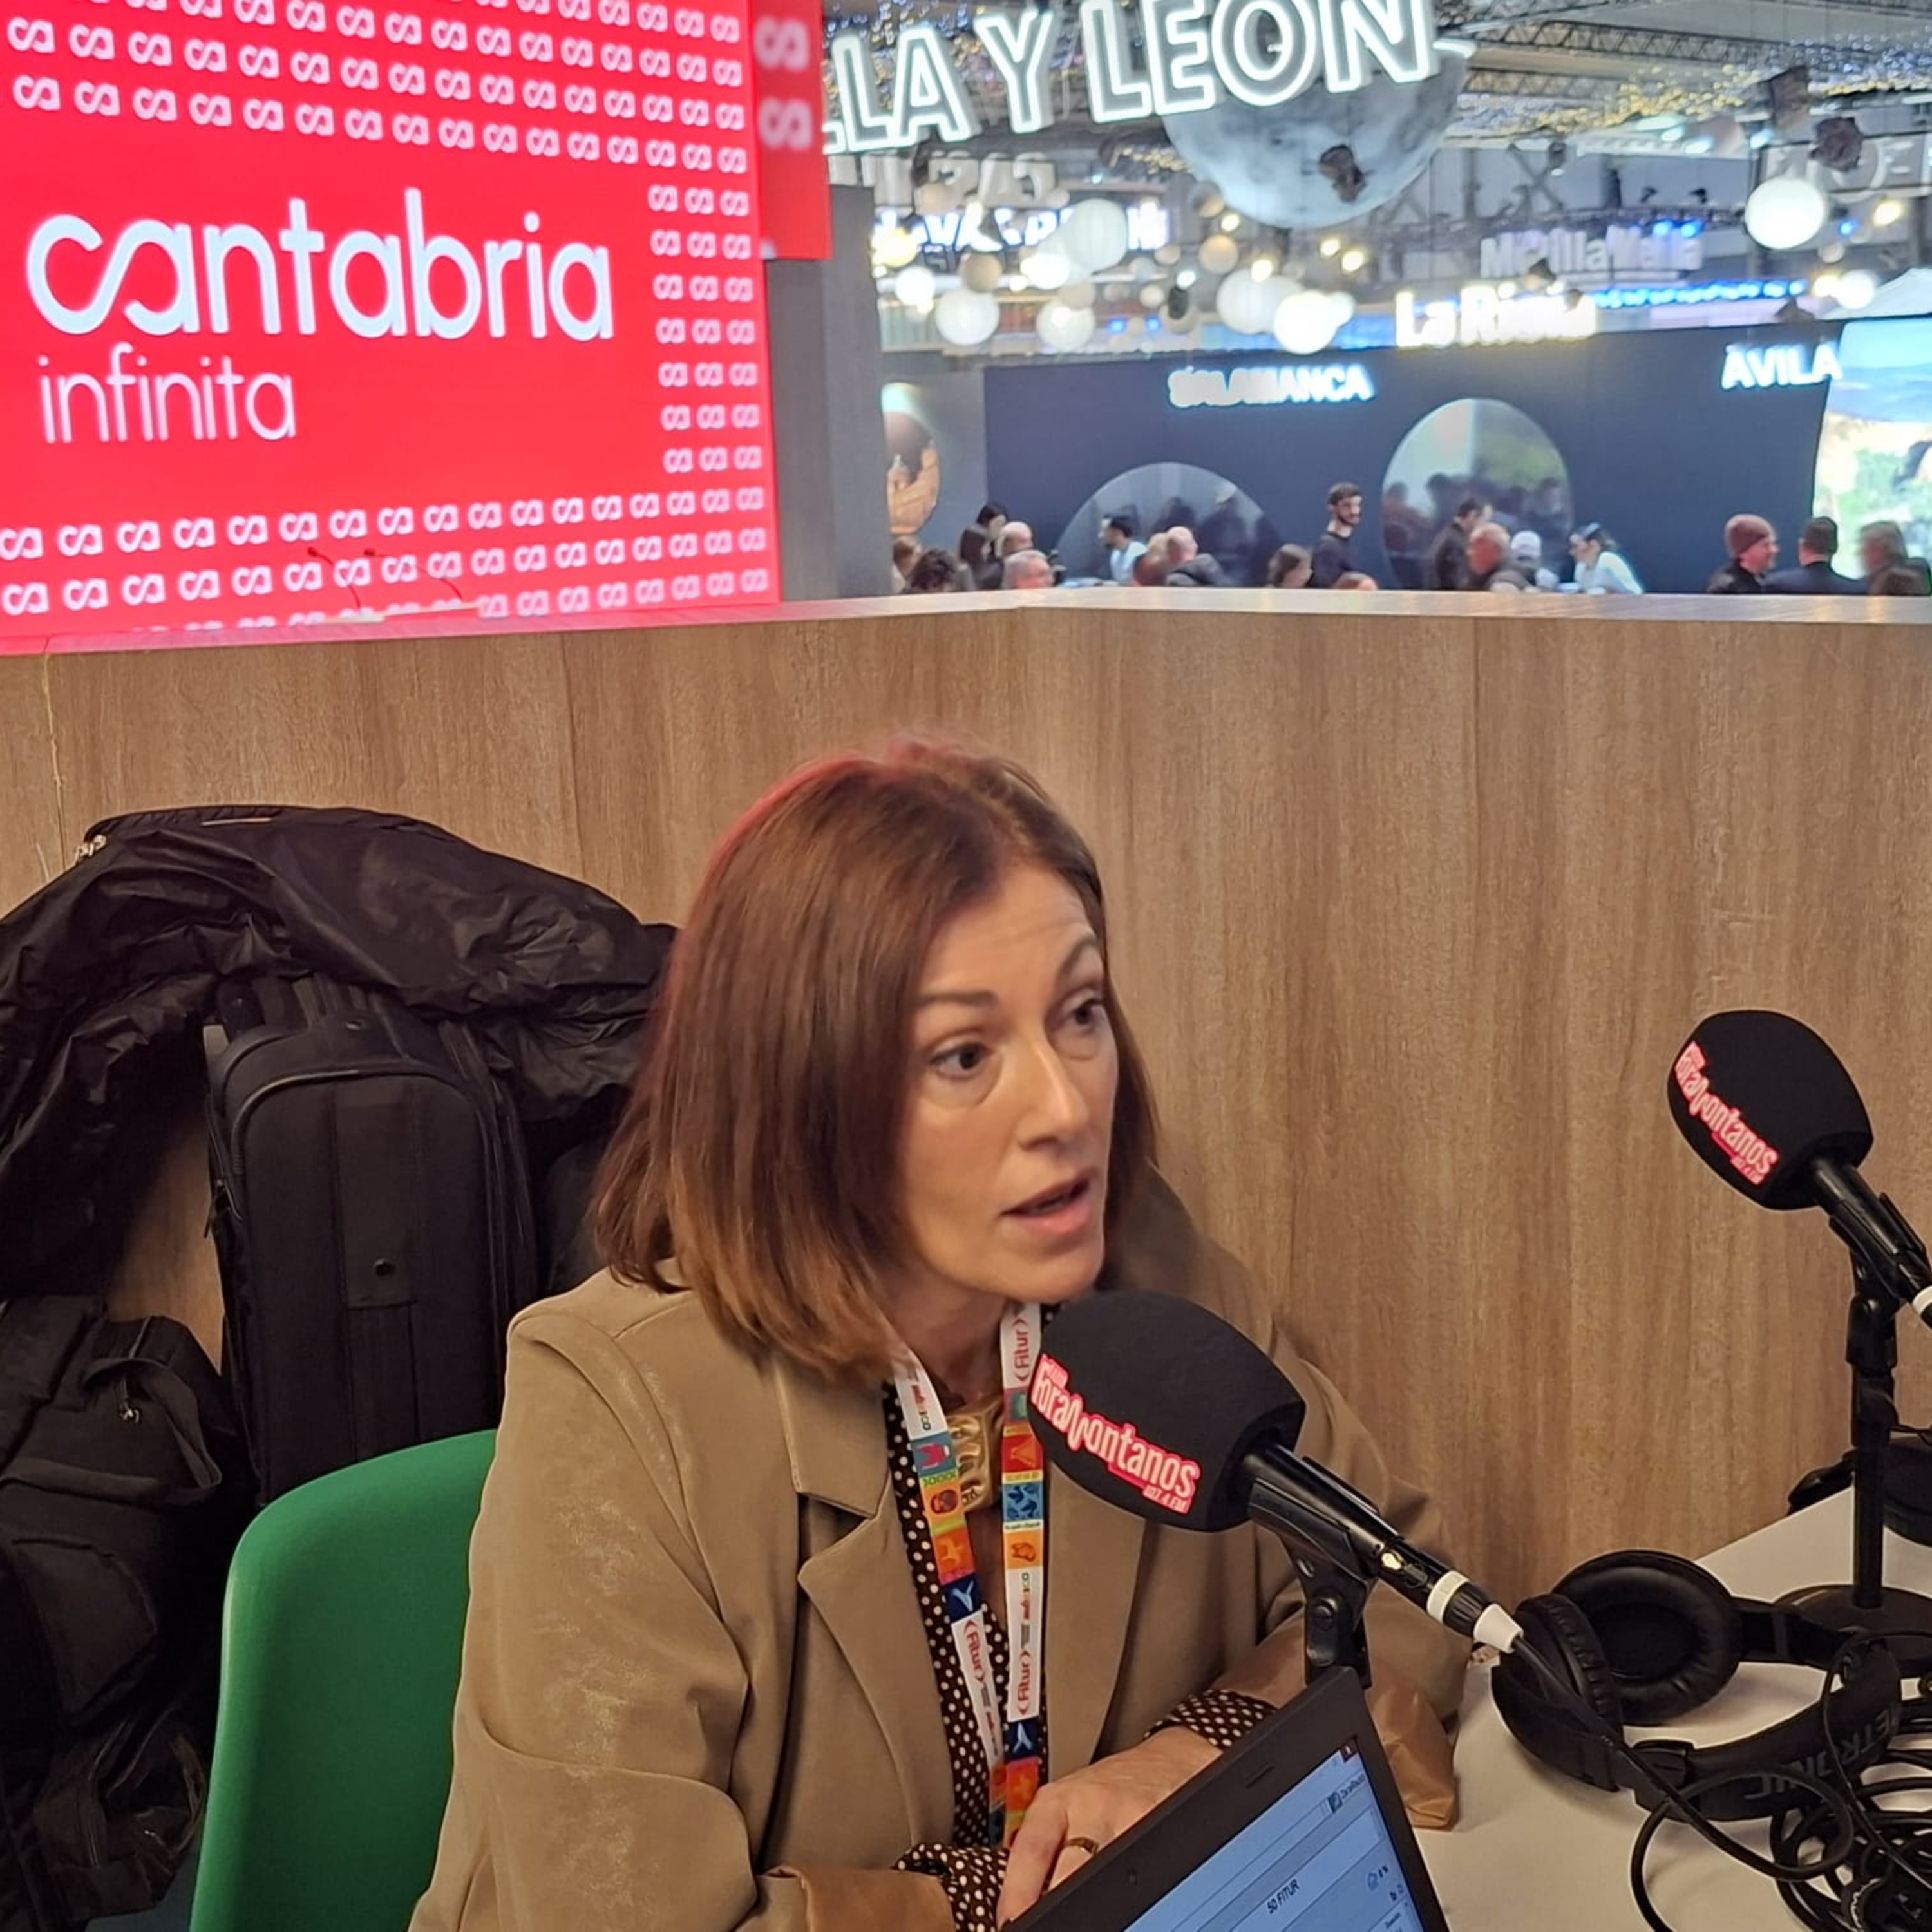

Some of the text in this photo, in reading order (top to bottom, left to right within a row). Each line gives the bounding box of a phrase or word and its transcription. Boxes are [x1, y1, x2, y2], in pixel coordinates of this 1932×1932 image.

[822, 27, 972, 155] LA
[973, 8, 1056, 133] Y
[26, 187, 614, 341] cantabria
[1395, 290, 1455, 348] La
[37, 342, 296, 444] infinita
